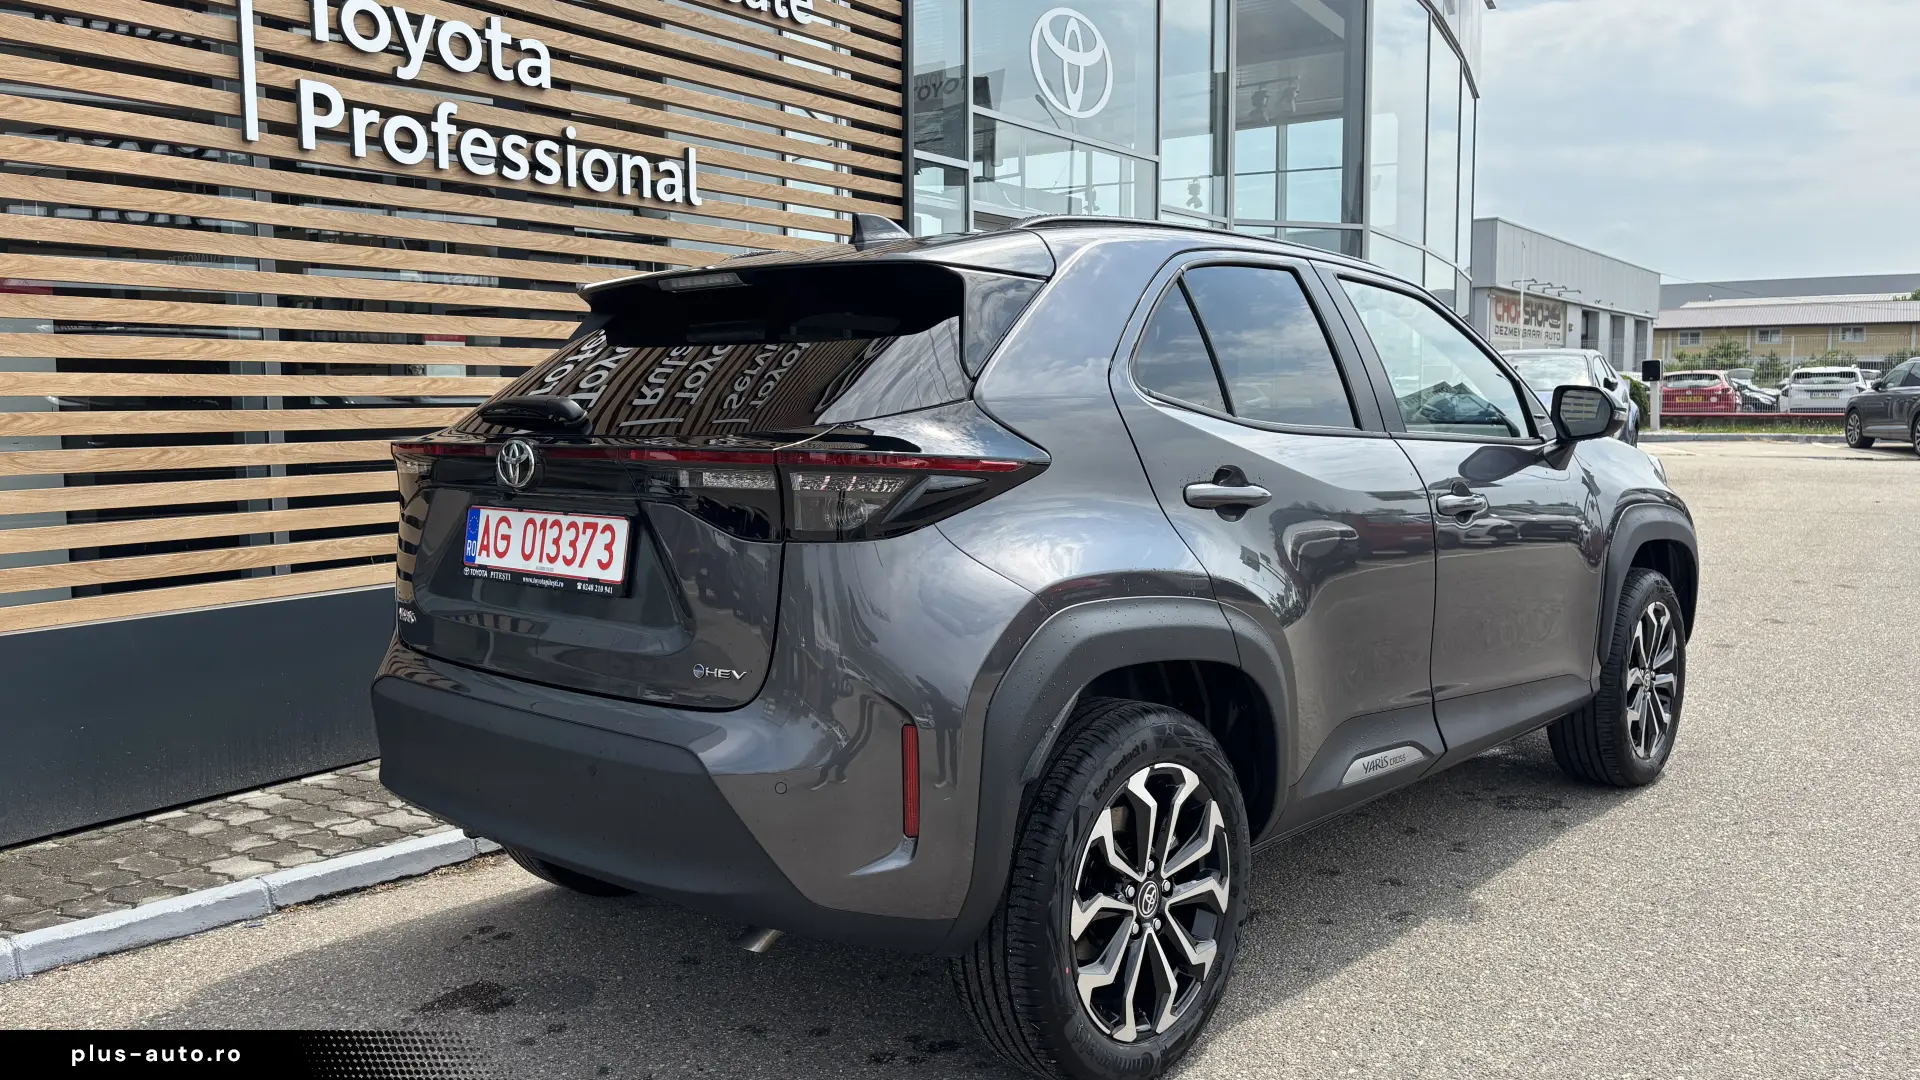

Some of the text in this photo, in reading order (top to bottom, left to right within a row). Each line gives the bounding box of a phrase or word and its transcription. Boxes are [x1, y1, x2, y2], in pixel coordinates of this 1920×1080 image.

[297, 78, 702, 205] Professional
[1545, 331, 1561, 341] AUTO
[466, 539, 477, 556] RO
[478, 514, 616, 571] AG 013373
[470, 568, 488, 577] TOYOTA
[705, 667, 747, 680] HEV
[1389, 754, 1406, 766] CROSS
